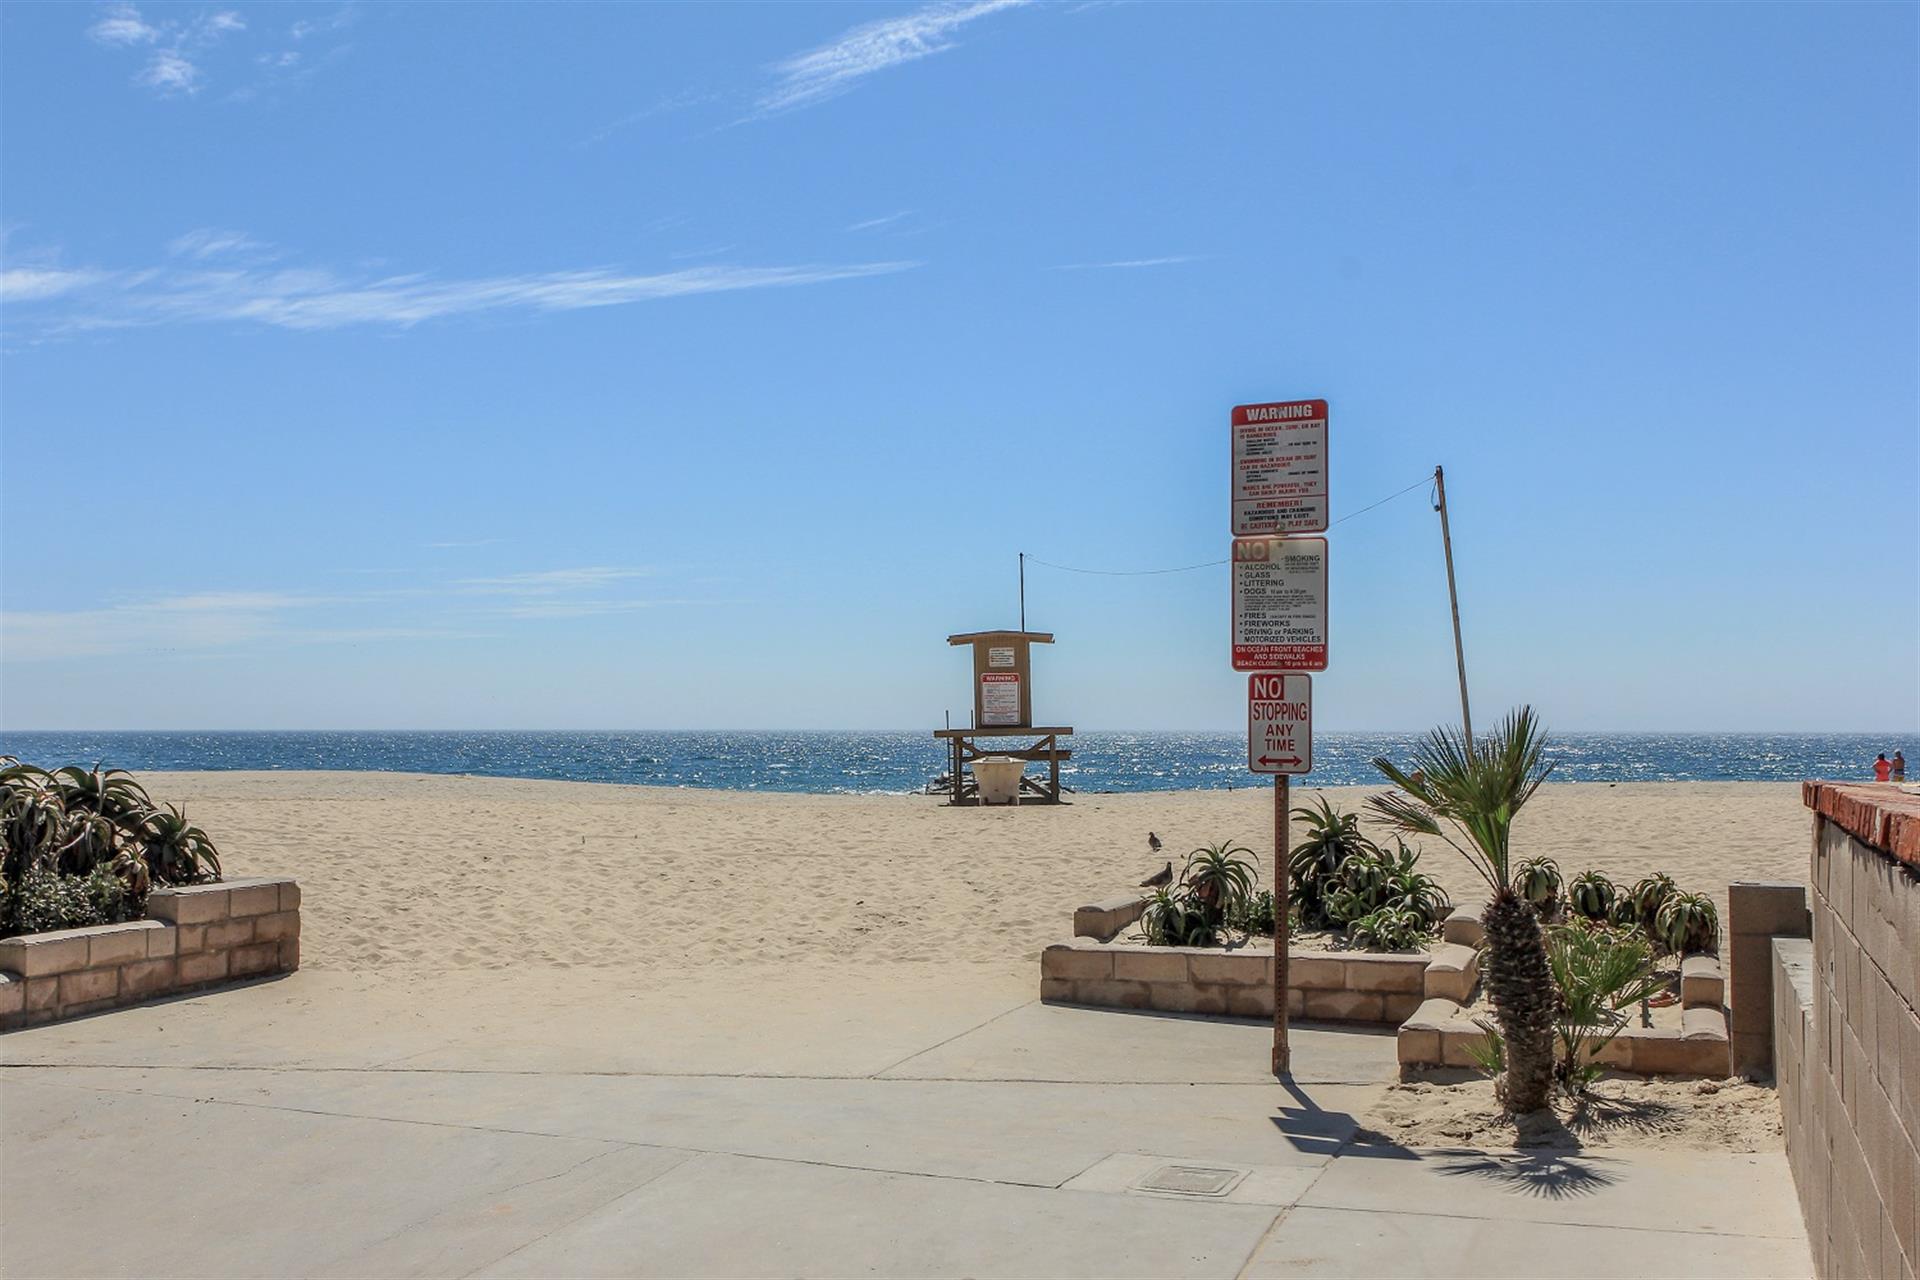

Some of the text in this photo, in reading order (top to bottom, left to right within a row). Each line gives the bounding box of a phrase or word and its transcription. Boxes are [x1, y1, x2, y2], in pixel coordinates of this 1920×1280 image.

[1246, 404, 1313, 421] WARNING
[1256, 500, 1302, 509] REMEMBER!
[1237, 542, 1265, 560] NO
[1254, 678, 1280, 698] NO
[1253, 702, 1308, 721] STOPPING
[1266, 724, 1294, 737] ANY
[1264, 739, 1296, 752] TIME
